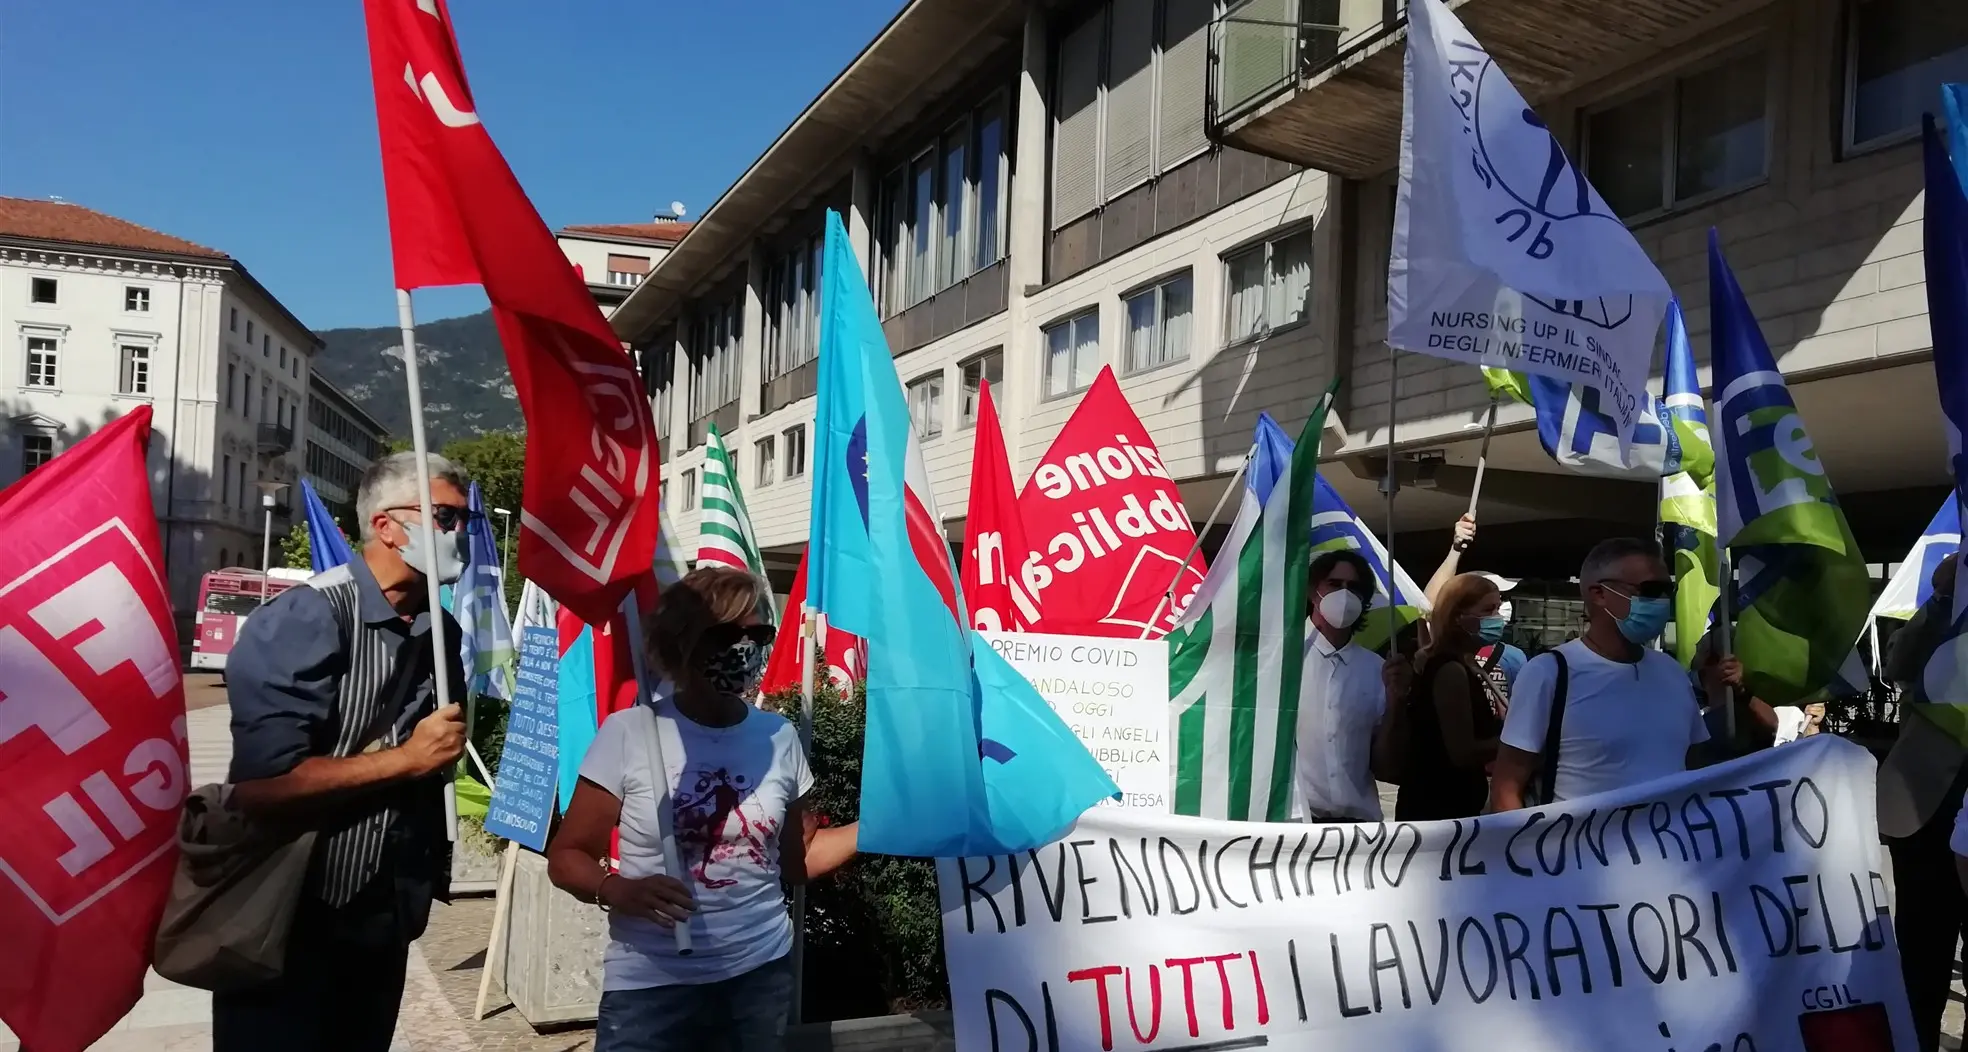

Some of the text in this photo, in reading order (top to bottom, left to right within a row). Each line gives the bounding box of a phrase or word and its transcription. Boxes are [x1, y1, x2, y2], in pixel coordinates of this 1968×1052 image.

[1430, 310, 1527, 335] NURSING
[1533, 320, 1558, 340] UP
[1565, 328, 1580, 347] IL
[1586, 335, 1636, 412] SINDAO
[1428, 332, 1633, 429] DEGLI INFERMIER ITALIAN
[992, 639, 1138, 668] PREMIO COVID
[1030, 678, 1134, 698] ANDALOSO
[1072, 701, 1114, 717] OGGI
[514, 712, 559, 739] TUTTO QUESTO
[1102, 726, 1159, 743] ANGELI
[1090, 747, 1161, 764] UBBLICA
[958, 776, 1829, 935] RIVENDICHIAMO IL CONTRATTO
[985, 981, 1060, 1052] DI
[1067, 950, 1270, 1052] TUTTI
[1288, 938, 1308, 1023] I
[1329, 891, 1738, 1018] LAVORATORI
[1802, 983, 1862, 1010] CGIL
